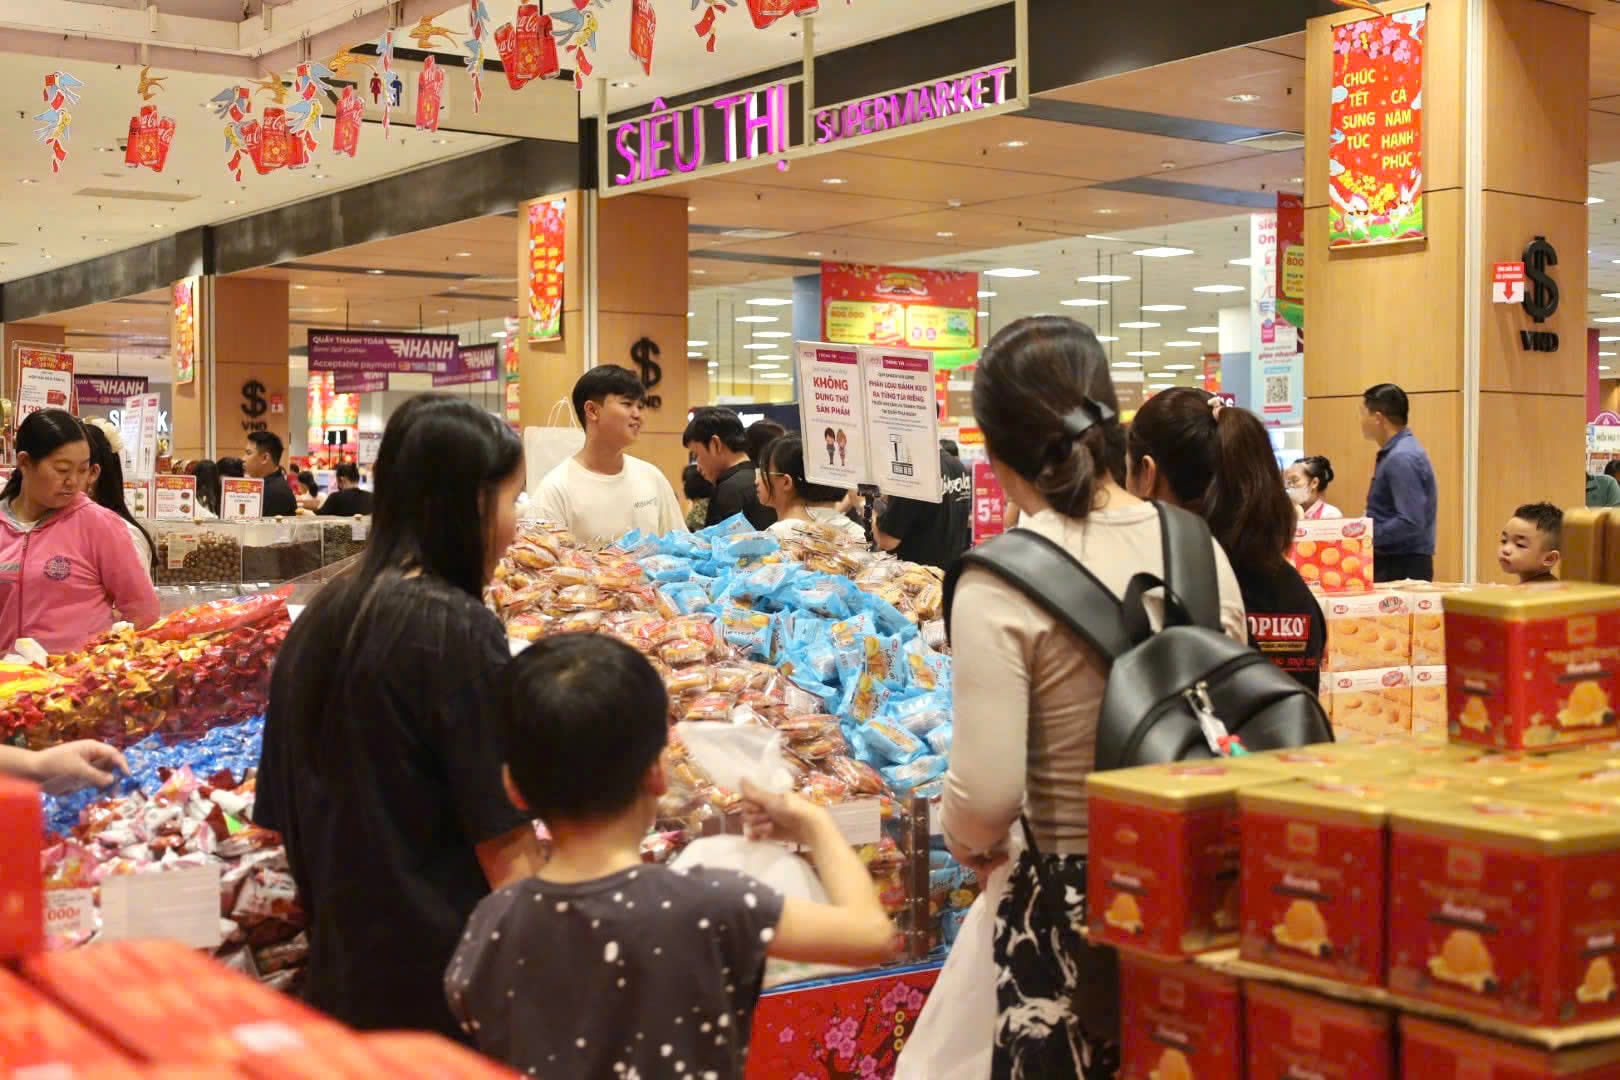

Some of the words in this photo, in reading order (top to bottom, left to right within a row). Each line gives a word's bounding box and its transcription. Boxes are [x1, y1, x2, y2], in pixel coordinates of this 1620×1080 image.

[1344, 68, 1376, 87] CHÚC
[816, 67, 1010, 144] SUPERMARKET
[1349, 88, 1370, 107] TẾT
[1342, 112, 1376, 129] SUNG
[615, 97, 703, 184] SIÊU
[714, 84, 788, 172] THỊ
[1347, 132, 1371, 150] TÚC
[1382, 151, 1413, 169] PHÚC
[336, 336, 363, 345] THANH
[399, 338, 455, 359] NHANH
[1520, 330, 1559, 352] VND
[312, 359, 360, 370] Acceptable
[360, 361, 397, 371] payment
[99, 380, 145, 395] NHANH
[813, 375, 849, 391] KHÔNG
